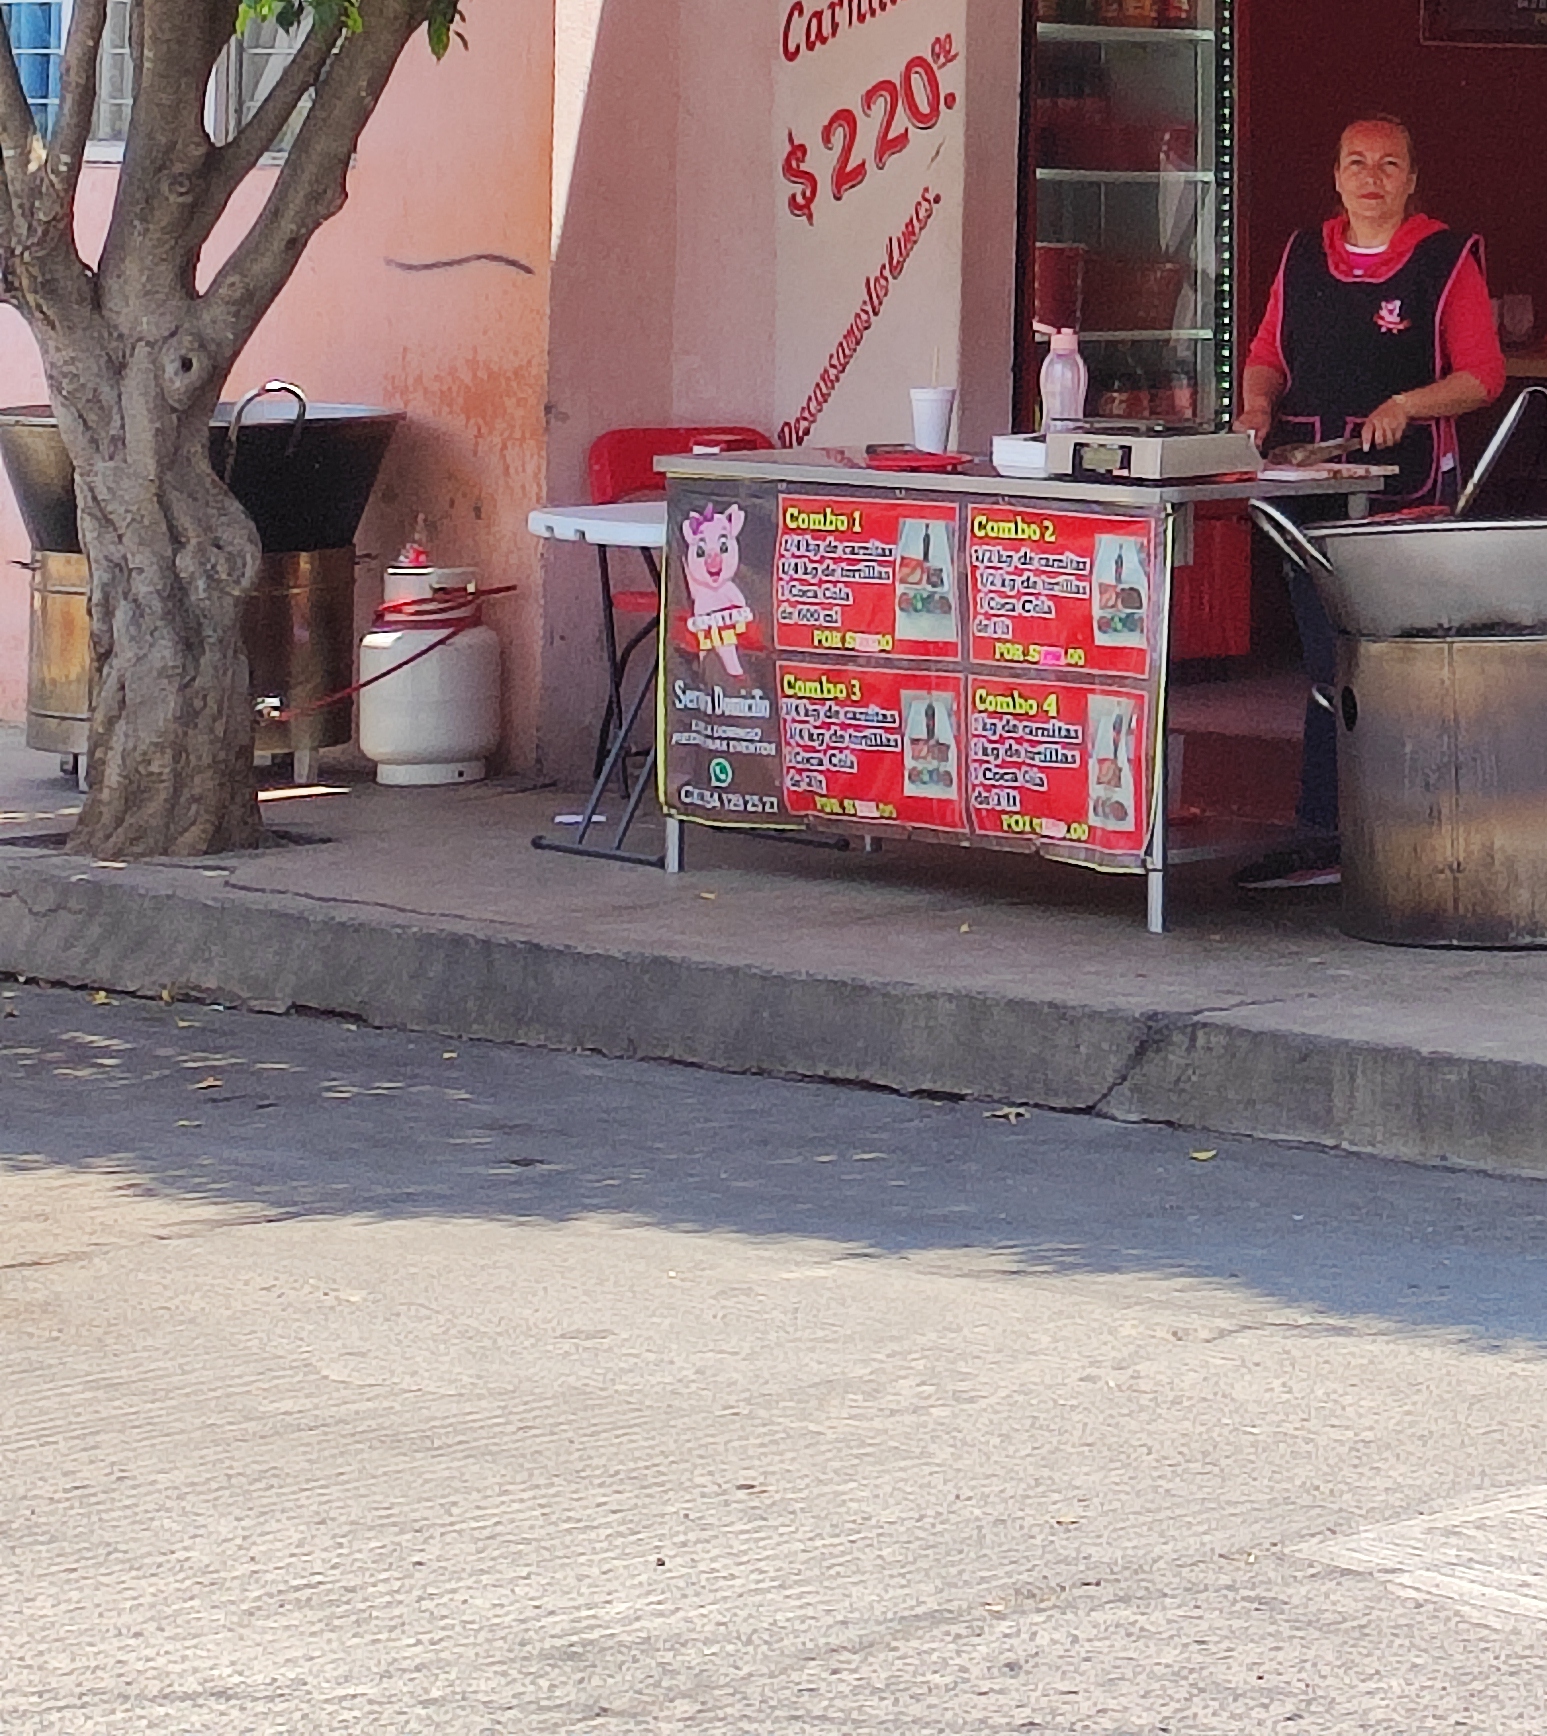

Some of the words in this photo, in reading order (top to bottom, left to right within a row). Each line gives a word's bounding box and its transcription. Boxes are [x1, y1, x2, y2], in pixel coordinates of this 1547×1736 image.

[786, 507, 848, 531] Combo
[852, 510, 862, 532] 1
[974, 515, 1040, 540] Combo
[1043, 520, 1056, 541] 2
[784, 674, 847, 698] Combo
[850, 679, 862, 700] 3
[976, 689, 1037, 714] Combo
[1043, 694, 1058, 716] 4
